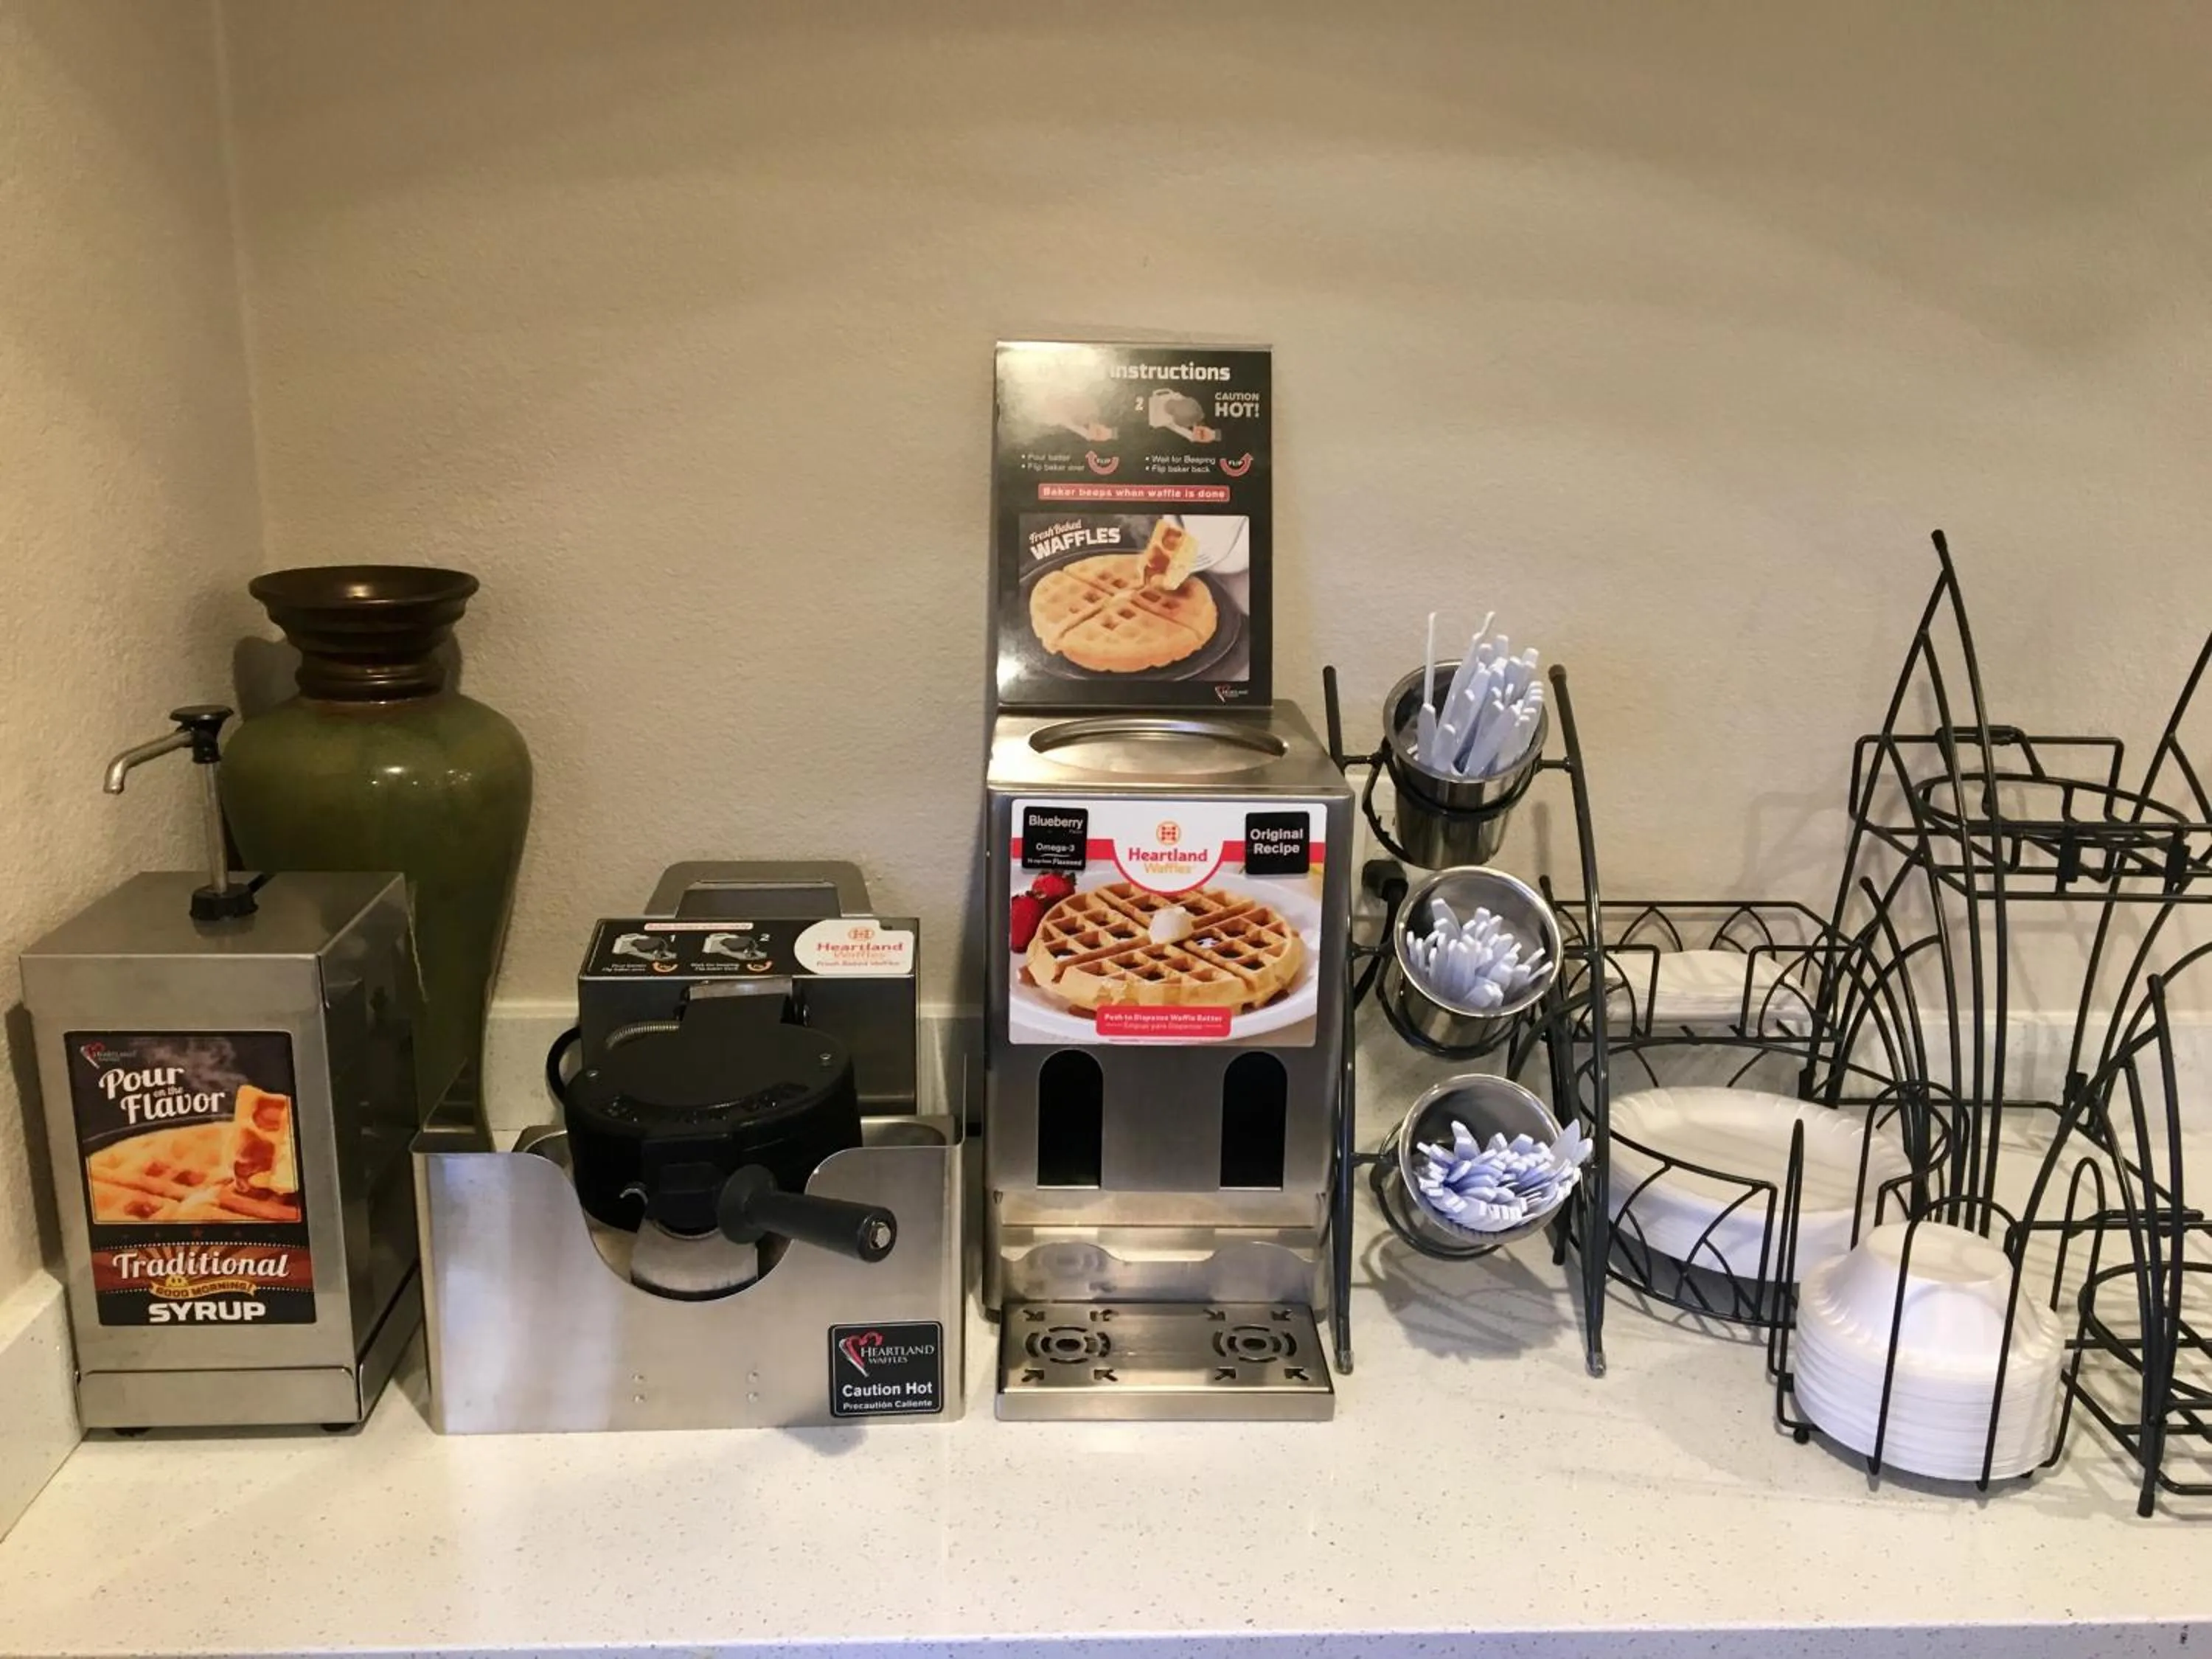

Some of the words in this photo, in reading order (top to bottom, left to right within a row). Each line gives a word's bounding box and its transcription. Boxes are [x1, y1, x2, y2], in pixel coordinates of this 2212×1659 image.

[1215, 392, 1260, 401] CAUTION
[1135, 397, 1144, 411] 2
[1215, 402, 1260, 418] HOT!
[1043, 486, 1075, 496] Baker
[1079, 487, 1113, 498] beeps
[1115, 487, 1144, 497] when
[1147, 488, 1181, 498] waffle
[1185, 489, 1195, 498] is
[1198, 490, 1225, 498] done
[1030, 527, 1121, 560] WAFFLES
[1029, 814, 1084, 830] Blueberry
[1250, 828, 1304, 842] Original
[1035, 843, 1075, 852] Omega-3
[1128, 847, 1208, 862] Heartland
[1253, 842, 1300, 856] Recipe
[1144, 863, 1192, 874] Waffles
[816, 942, 904, 951] Heartland
[98, 1067, 185, 1099] Pour
[153, 1089, 166, 1098] on
[167, 1085, 184, 1096] the
[120, 1091, 226, 1124] Flavor
[112, 1251, 289, 1279] Traditional
[155, 1286, 189, 1298] GOOD
[190, 1280, 253, 1295] MORNING!
[147, 1300, 266, 1324] SYRUP
[860, 1344, 935, 1357] HEARTLAND
[868, 1355, 908, 1364] WAFFLES
[842, 1382, 901, 1397] Caution
[905, 1381, 933, 1394] Hot
[894, 1399, 933, 1408] Caliente
